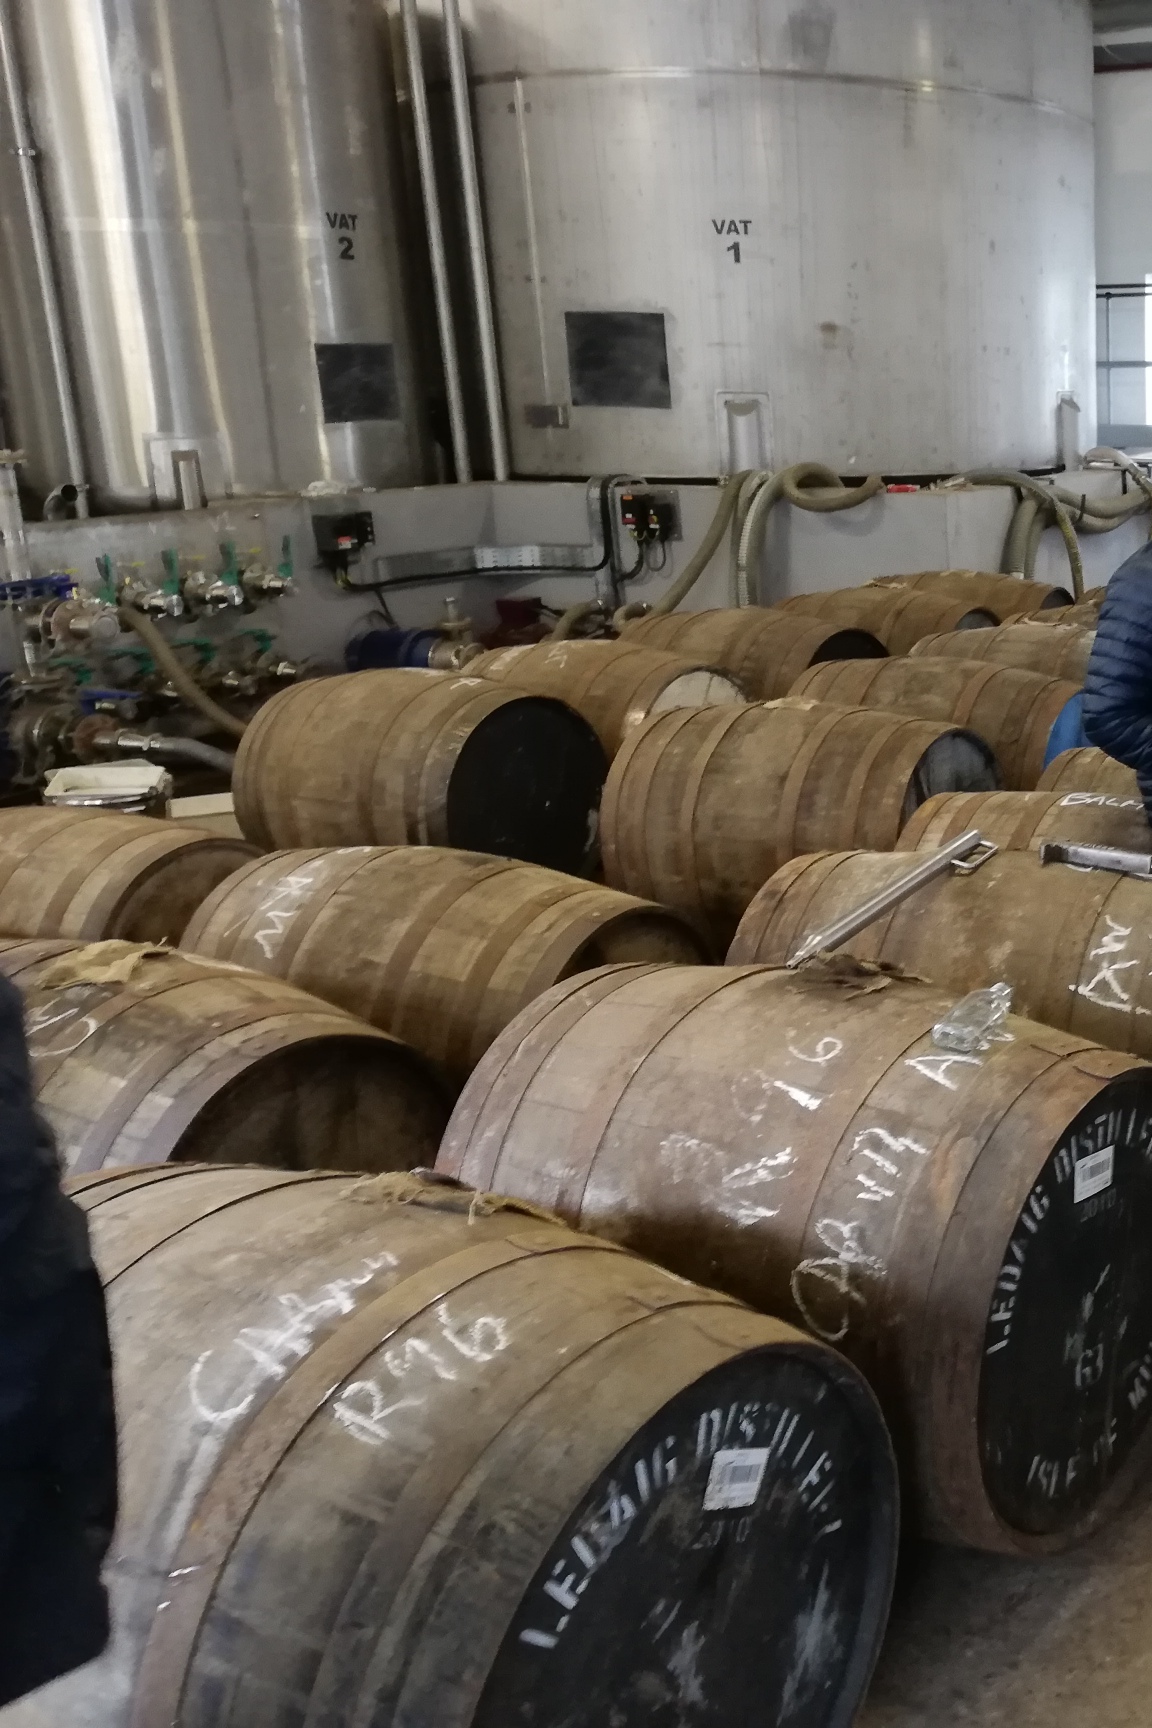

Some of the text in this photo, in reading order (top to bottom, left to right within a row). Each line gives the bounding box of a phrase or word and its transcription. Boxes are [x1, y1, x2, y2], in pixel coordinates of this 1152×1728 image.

[325, 212, 358, 231] VAT
[711, 218, 752, 236] VAT
[338, 236, 355, 261] 2
[726, 241, 741, 264] 1
